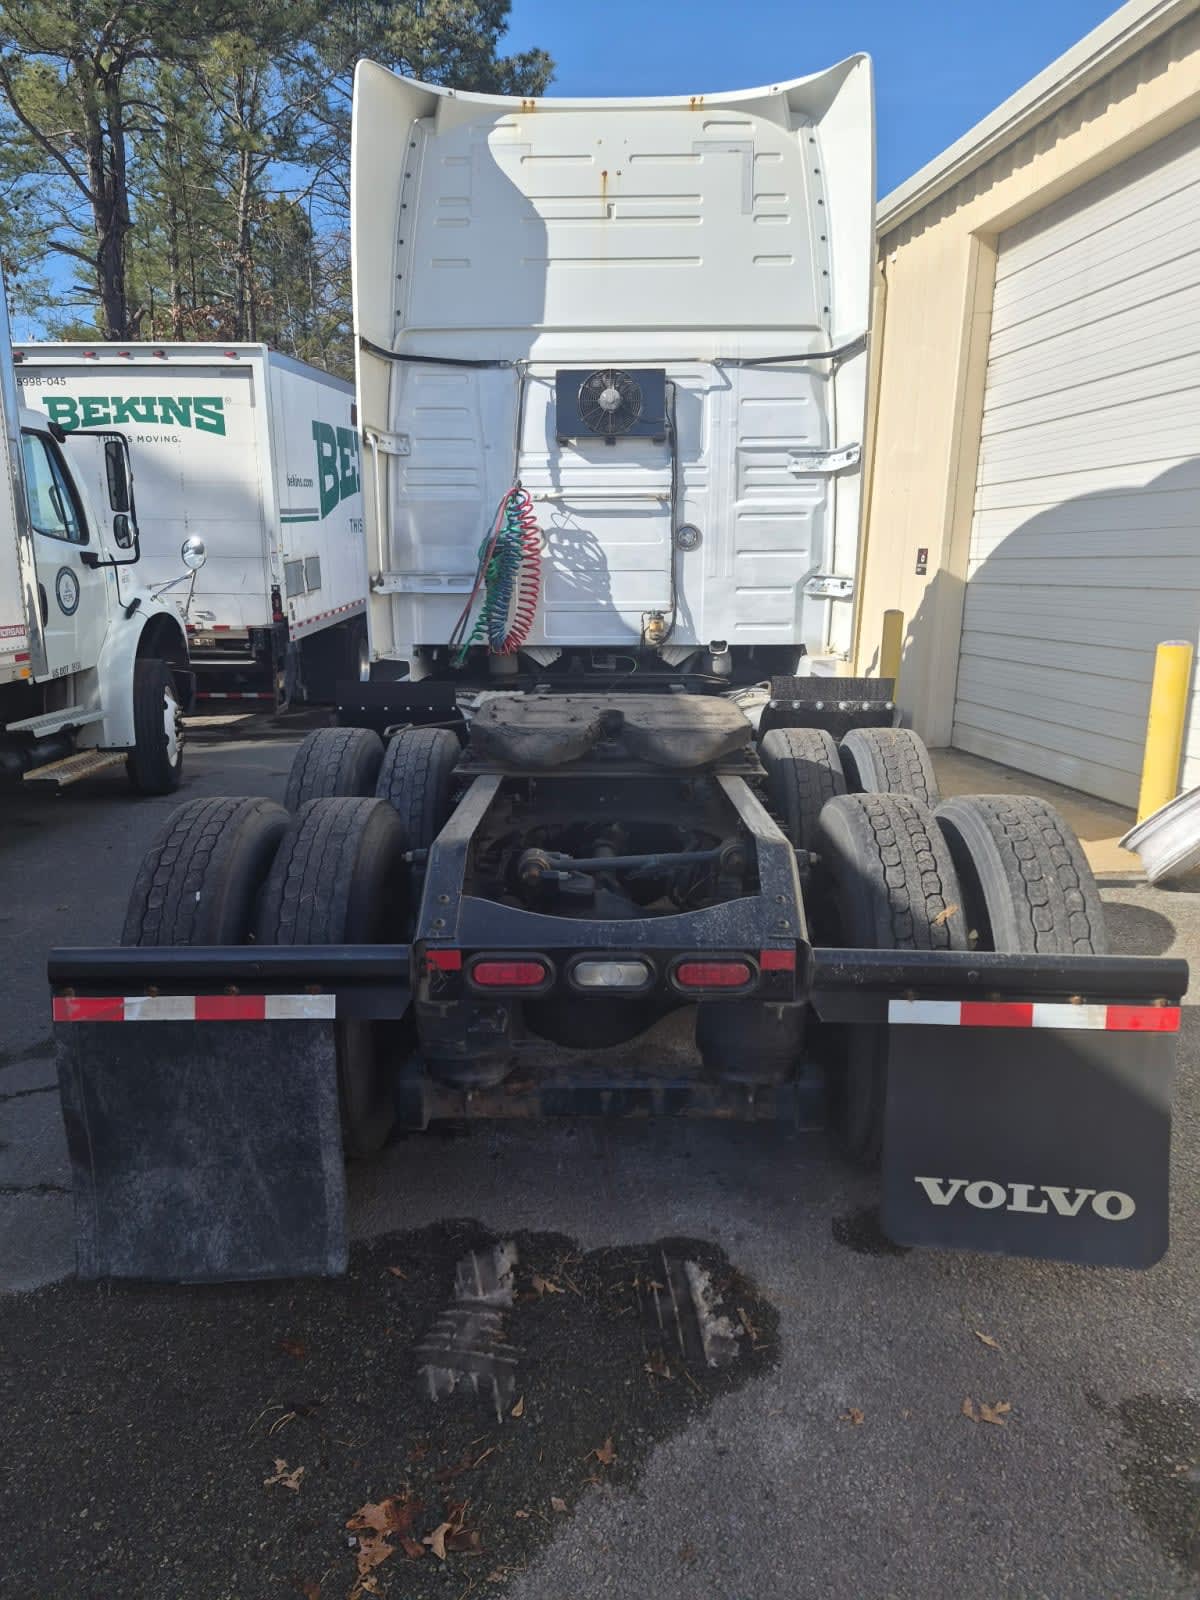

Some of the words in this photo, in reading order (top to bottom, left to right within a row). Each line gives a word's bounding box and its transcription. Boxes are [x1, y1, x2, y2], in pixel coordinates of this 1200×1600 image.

[42, 396, 226, 436] BEKINS
[137, 435, 182, 443] MOVING.
[286, 472, 313, 488] bekins.com
[914, 1176, 1137, 1221] VOLVO
